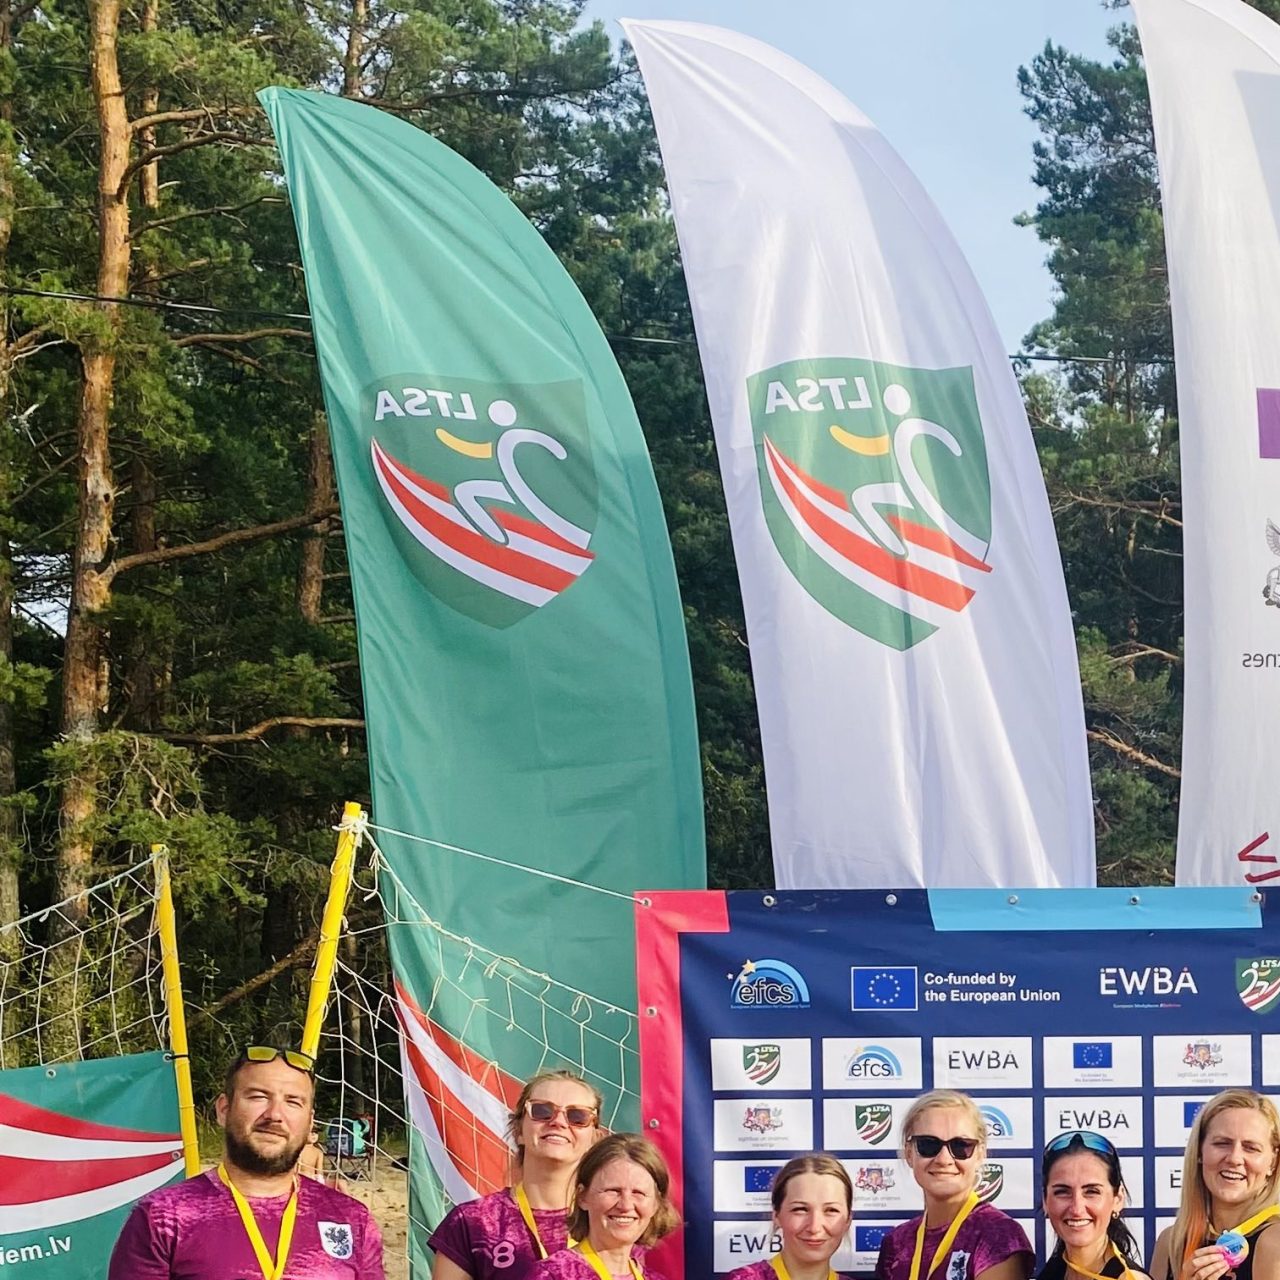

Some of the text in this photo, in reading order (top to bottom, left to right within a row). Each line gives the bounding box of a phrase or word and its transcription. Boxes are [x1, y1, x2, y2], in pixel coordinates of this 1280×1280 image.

[924, 972, 1016, 987] Co-funded by
[1100, 967, 1198, 996] EWBA
[738, 977, 795, 1004] efcs
[925, 989, 1061, 1004] the European Union
[851, 1059, 892, 1077] efcs
[948, 1050, 1019, 1070] EWBA
[1059, 1110, 1129, 1129] EWBA
[985, 1123, 1002, 1137] cs
[729, 1234, 783, 1254] EWB
[492, 1241, 515, 1268] 8
